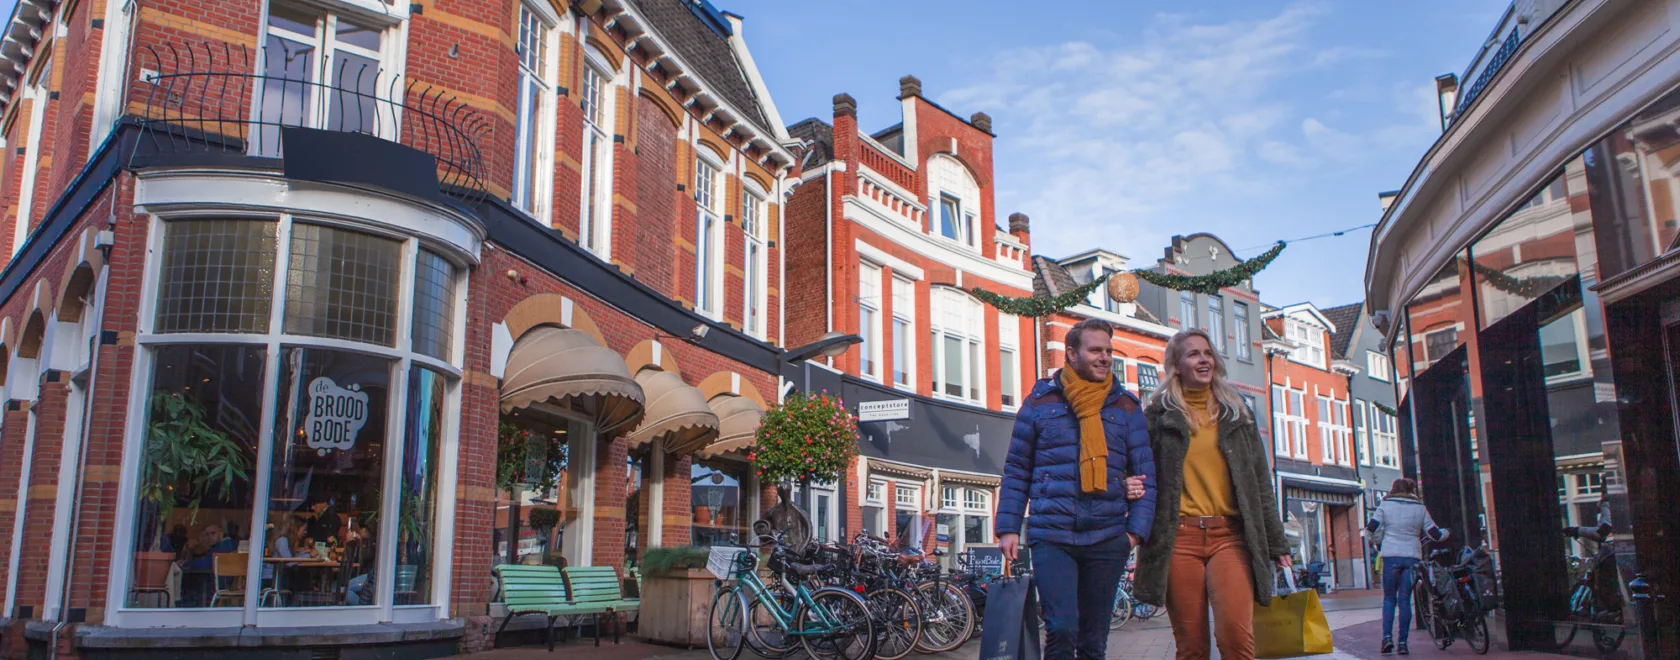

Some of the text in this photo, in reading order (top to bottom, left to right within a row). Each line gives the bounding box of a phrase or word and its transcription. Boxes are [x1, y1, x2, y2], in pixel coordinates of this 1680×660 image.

[315, 380, 329, 393] de
[314, 394, 363, 420] BROOD
[860, 402, 908, 410] conceptstore
[312, 419, 351, 443] BODE
